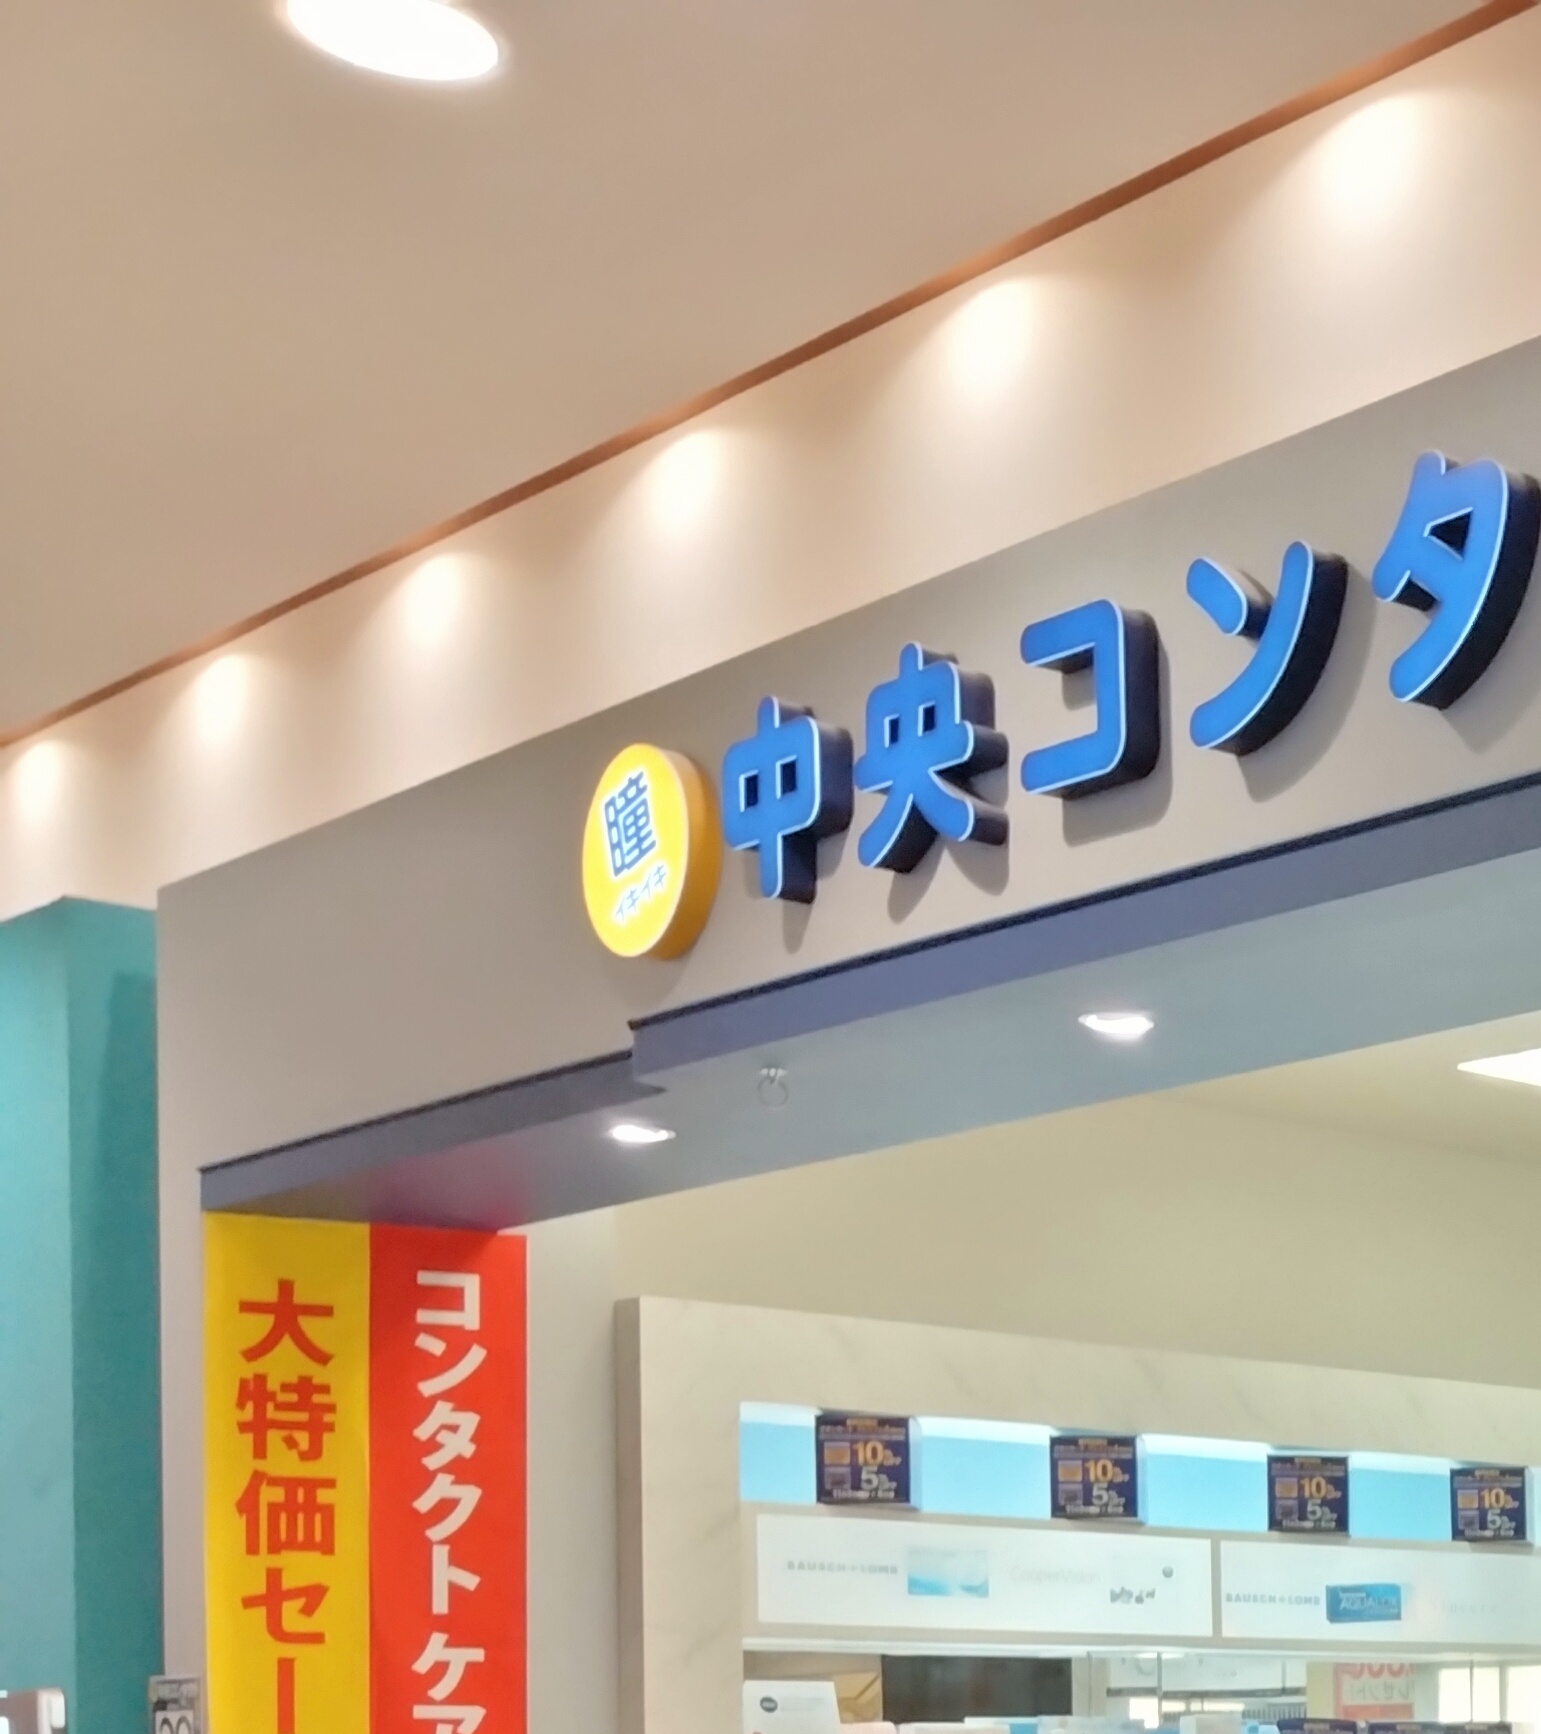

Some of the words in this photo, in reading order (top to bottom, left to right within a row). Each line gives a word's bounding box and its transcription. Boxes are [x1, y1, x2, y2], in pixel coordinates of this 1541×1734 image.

[604, 771, 656, 876] 瞳
[1225, 1591, 1277, 1604] BAUSCH
[1288, 1594, 1321, 1606] LOMB
